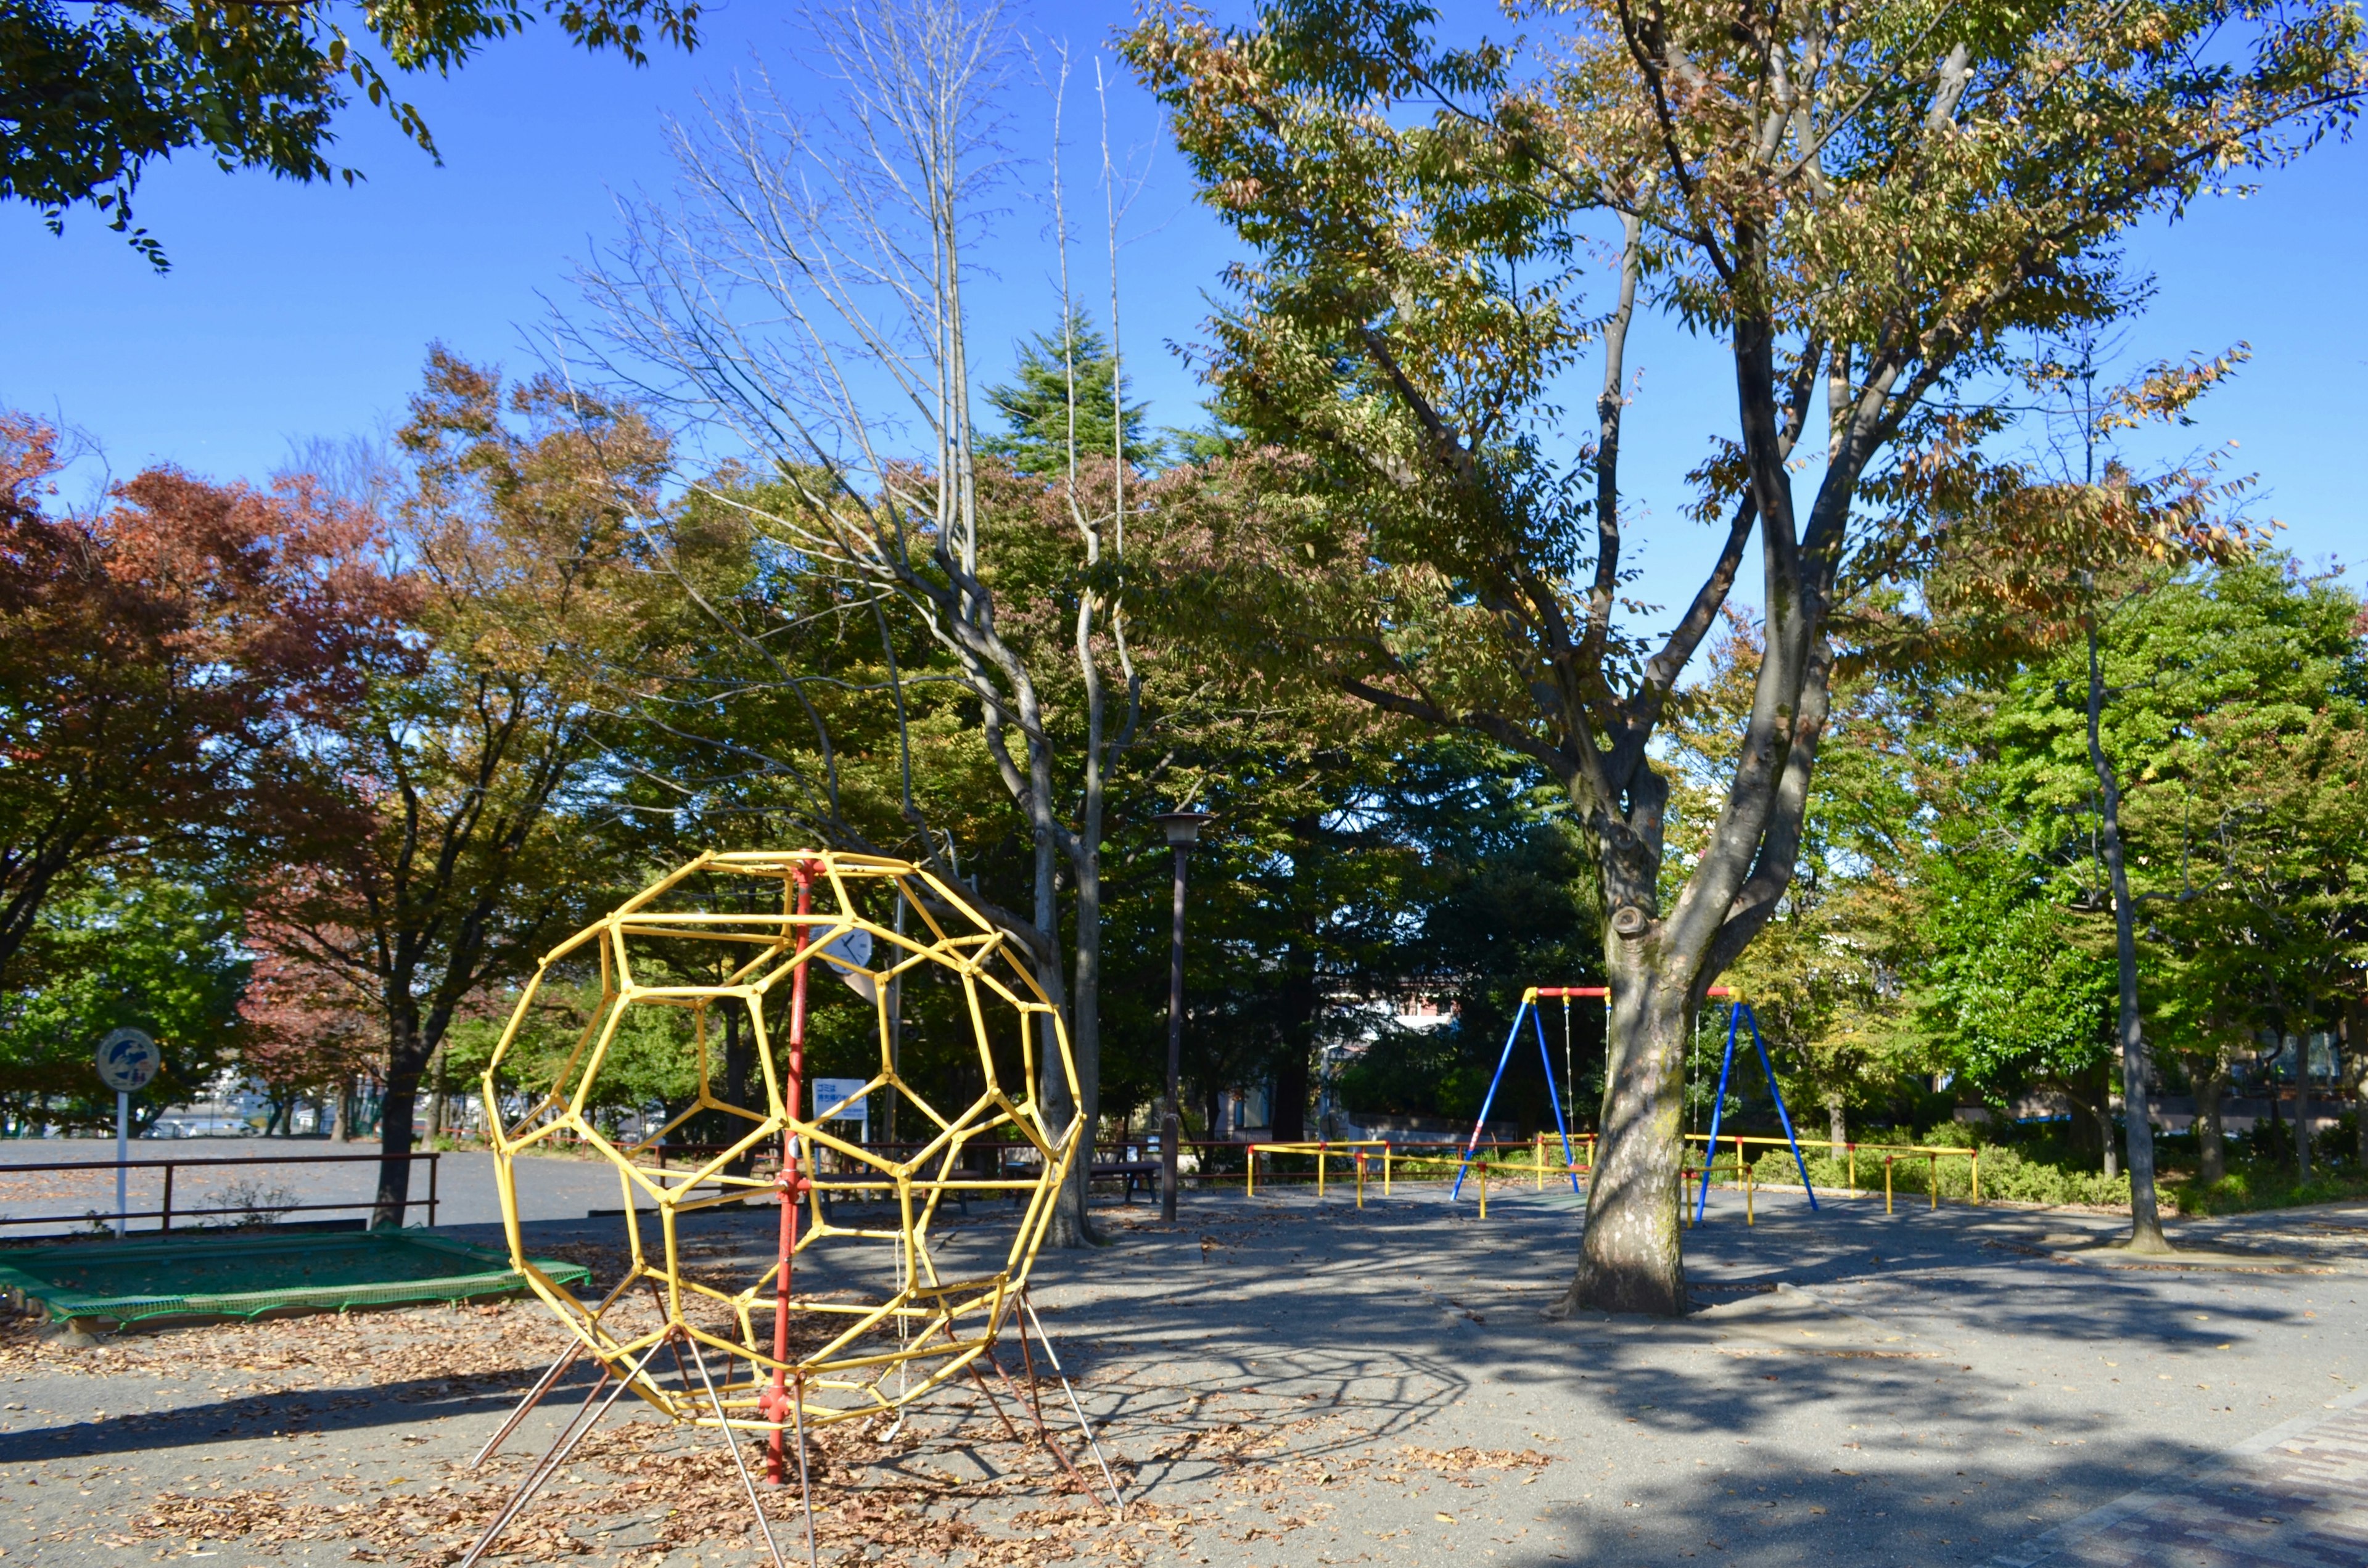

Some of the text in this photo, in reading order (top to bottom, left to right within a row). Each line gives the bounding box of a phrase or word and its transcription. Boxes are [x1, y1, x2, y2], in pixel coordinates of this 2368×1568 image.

[817, 1084, 836, 1092] ゴミは
[818, 1094, 865, 1102] 持ち帰りまう
